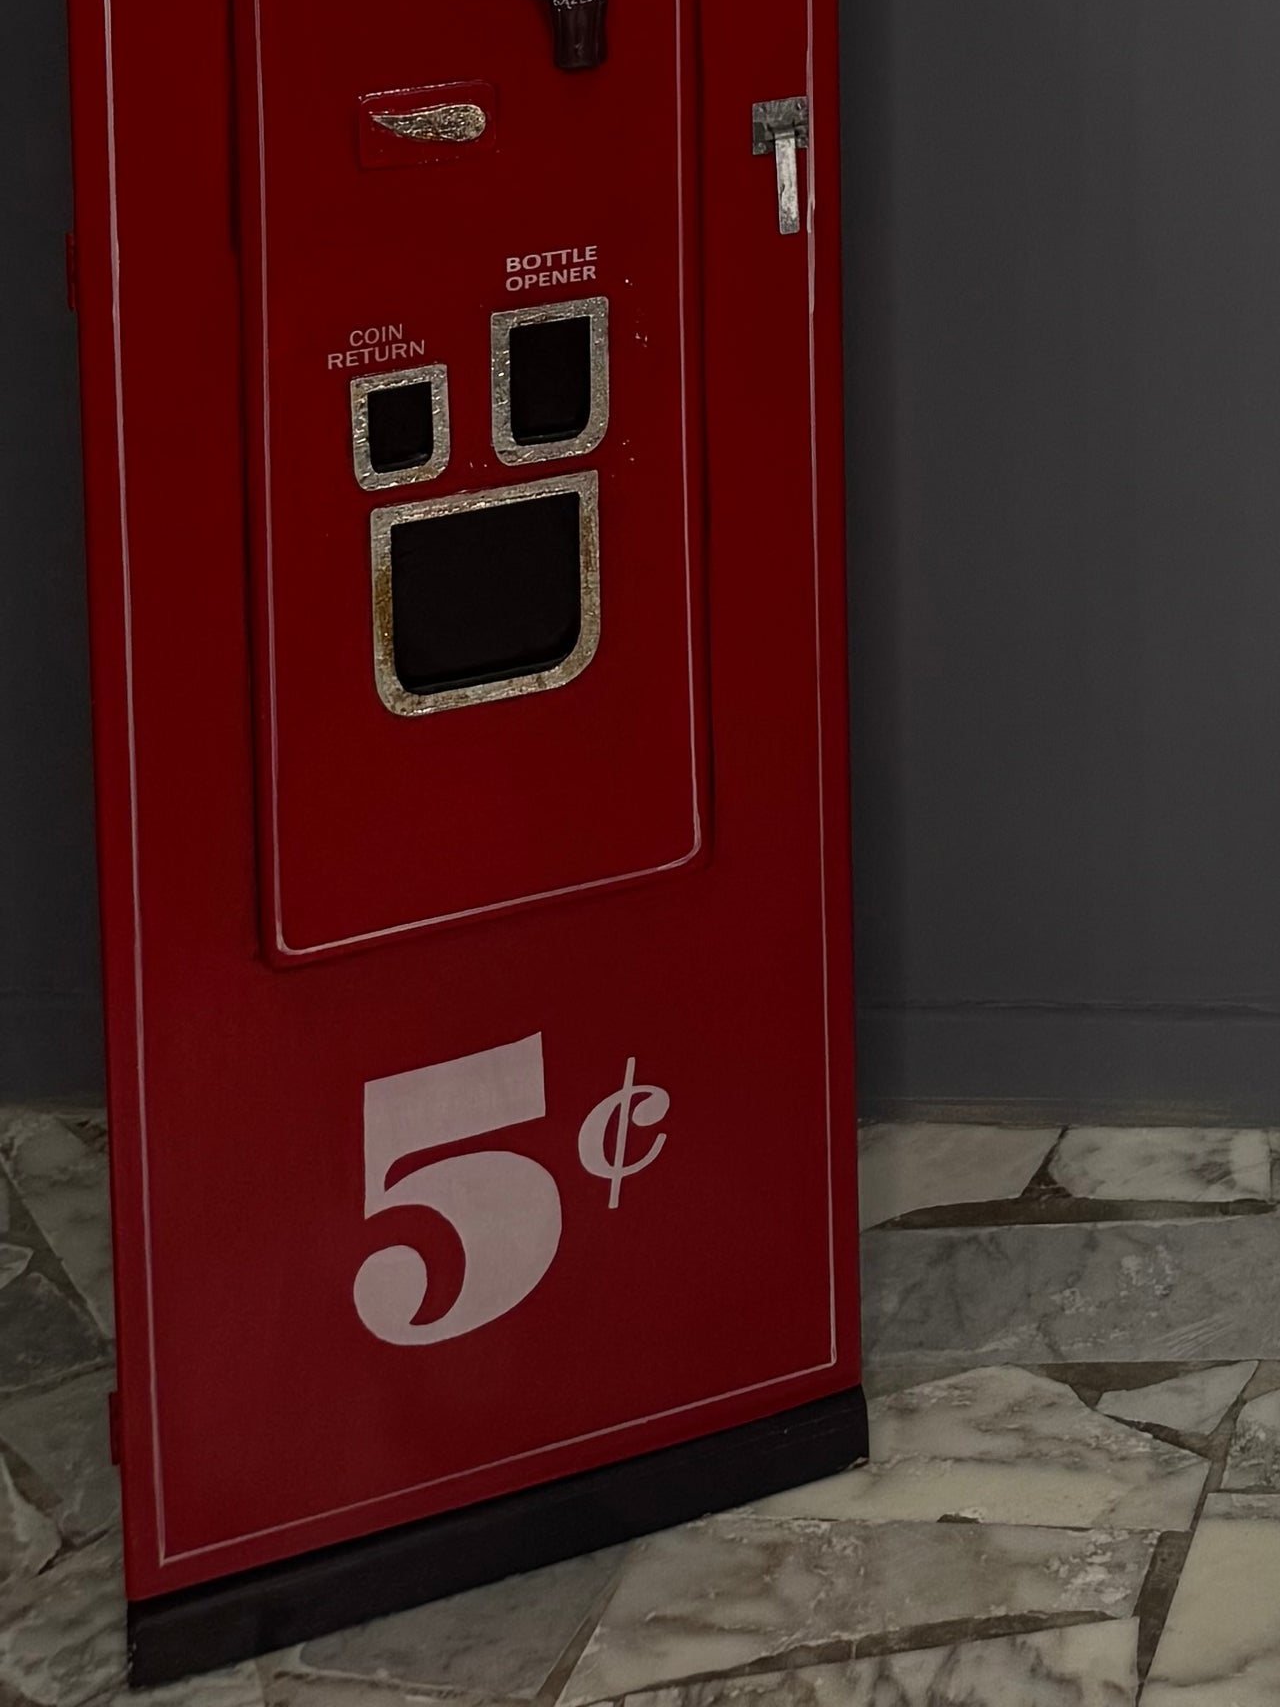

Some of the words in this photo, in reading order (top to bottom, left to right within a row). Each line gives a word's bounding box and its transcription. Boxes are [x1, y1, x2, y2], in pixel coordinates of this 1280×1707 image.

[505, 245, 599, 275] BOTTLE
[505, 265, 598, 293] OPENER
[348, 323, 403, 347] COIN
[326, 339, 426, 370] RETURN
